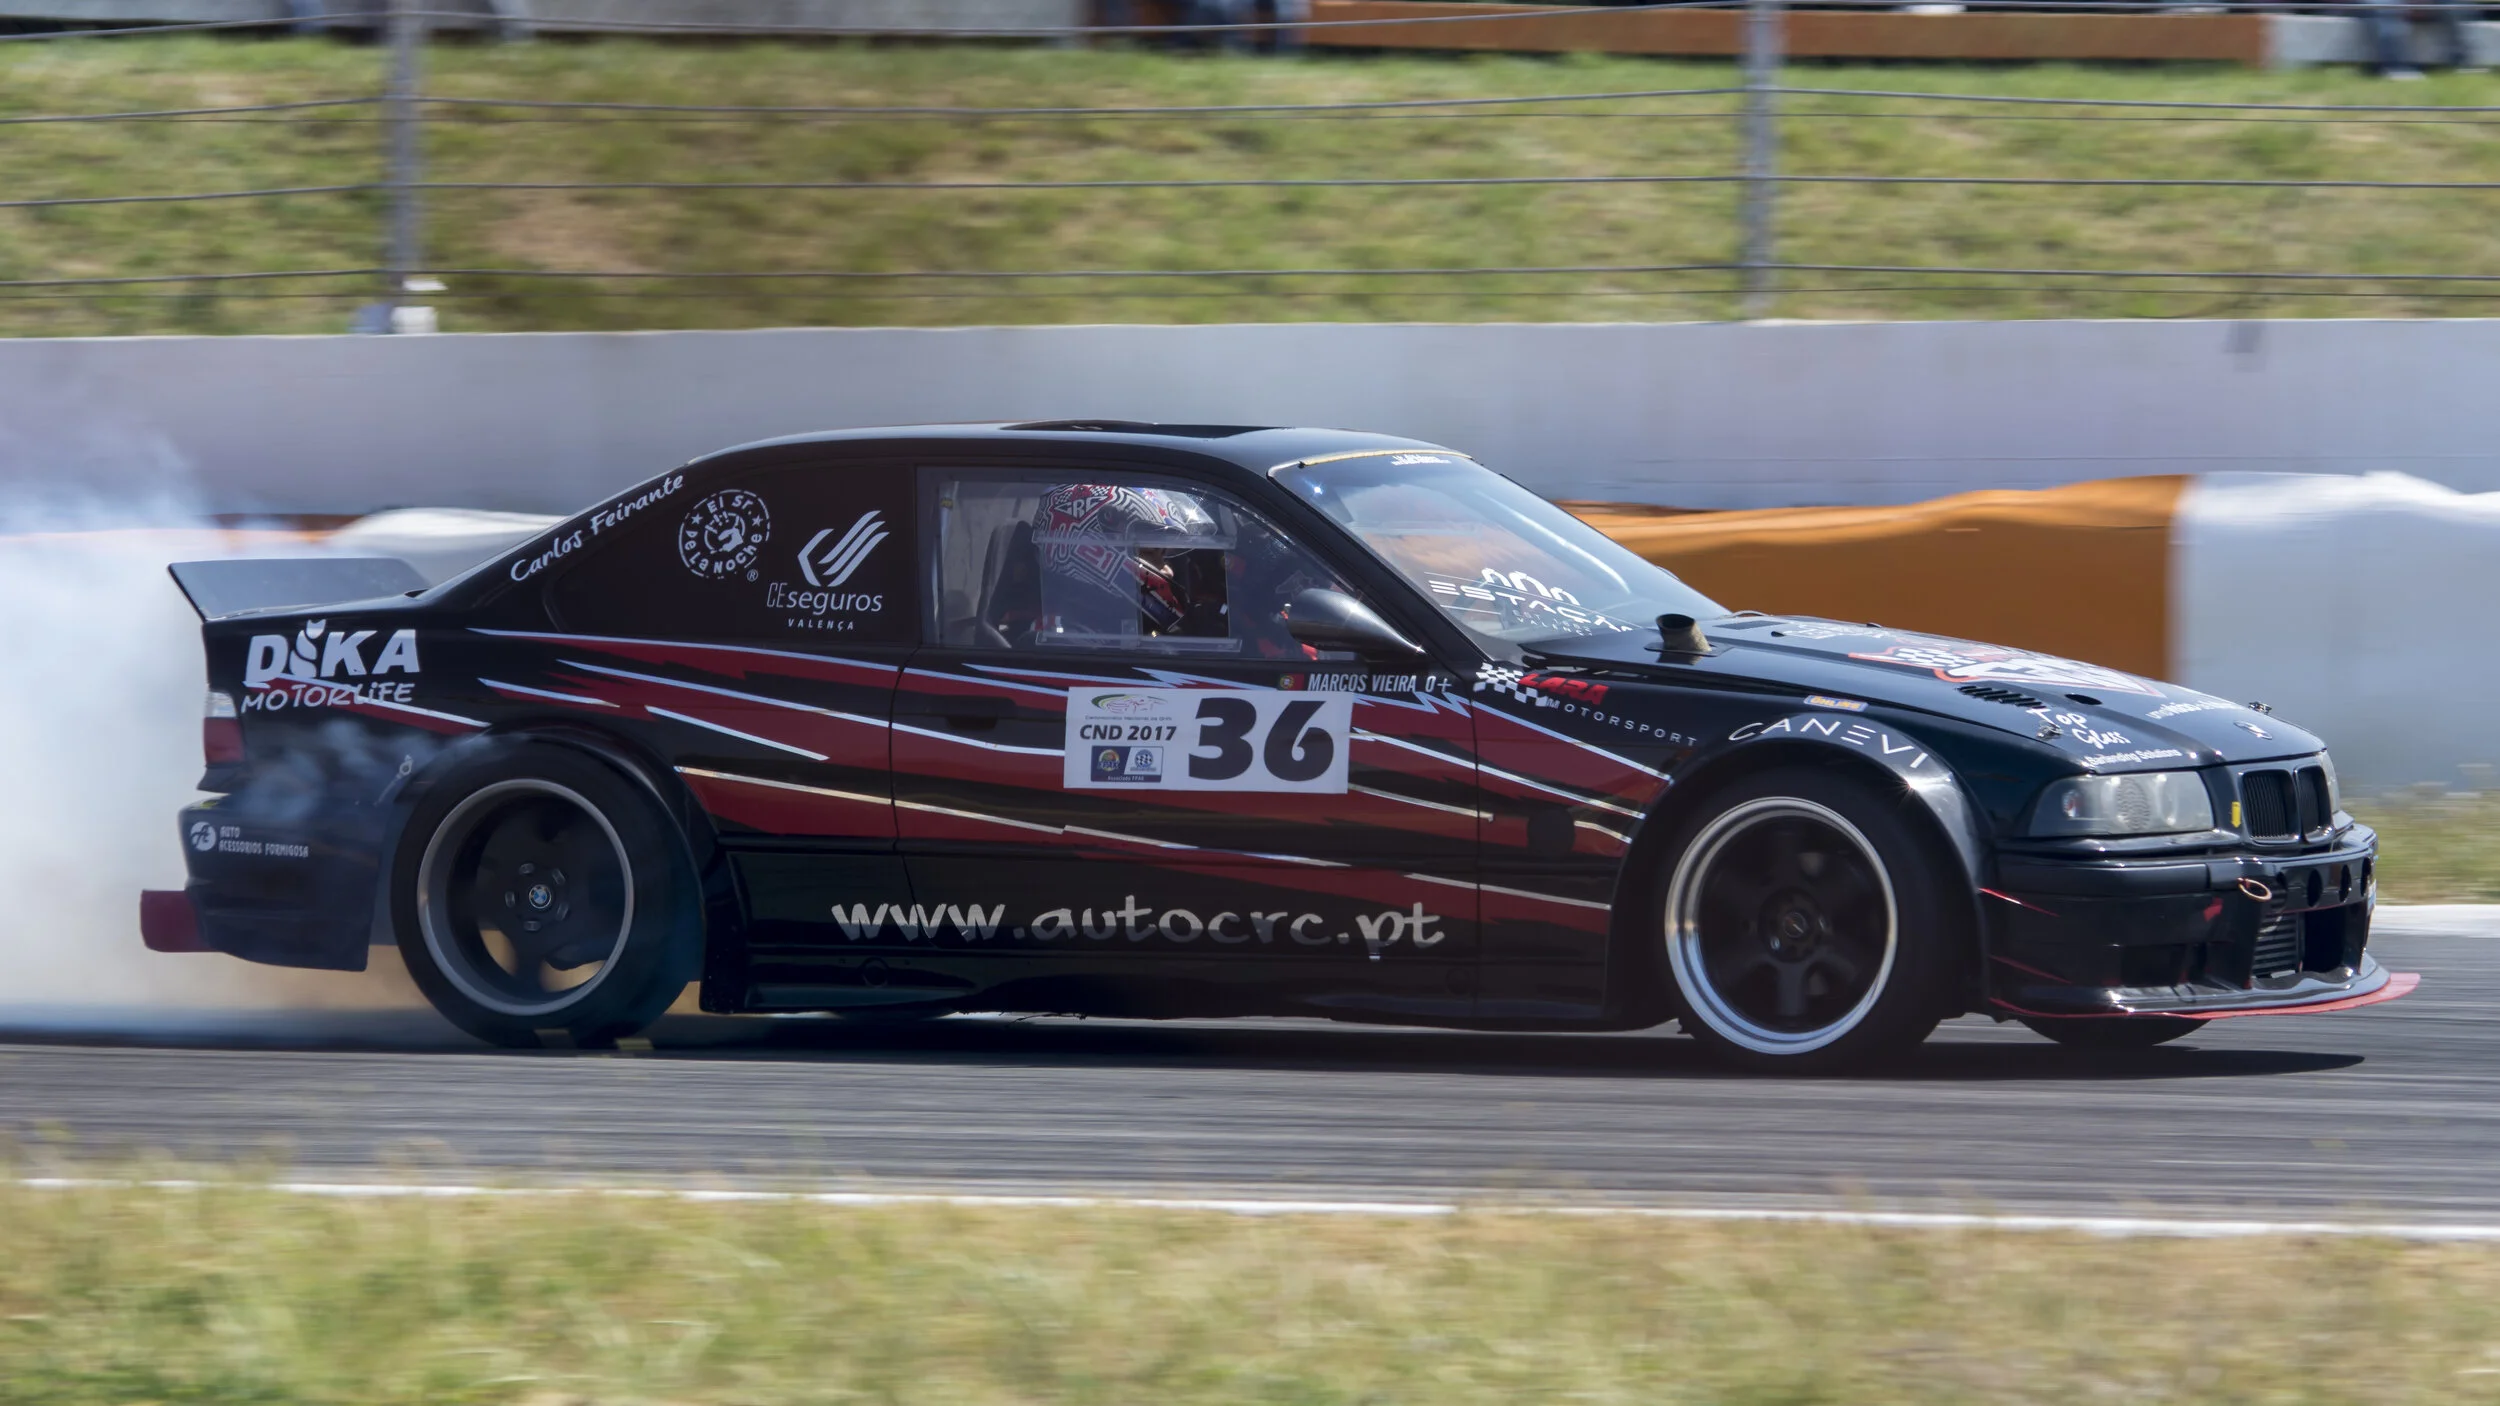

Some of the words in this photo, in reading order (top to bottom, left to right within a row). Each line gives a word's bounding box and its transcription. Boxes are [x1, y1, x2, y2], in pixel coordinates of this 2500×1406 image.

[510, 529, 583, 582] Carlos
[590, 474, 684, 536] Feirante
[787, 618, 855, 632] VALENÇA
[1307, 673, 1369, 692] MARCOS
[1372, 674, 1417, 693] VIEIRA
[1079, 724, 1123, 741] CND
[1126, 724, 1178, 742] 2017
[1188, 697, 1335, 782] 36
[1546, 699, 1698, 748] MOTORSPORT
[1728, 717, 1929, 769] CANEVI
[220, 826, 240, 838] AUTO
[831, 895, 1445, 962] www.autocrc.pt
